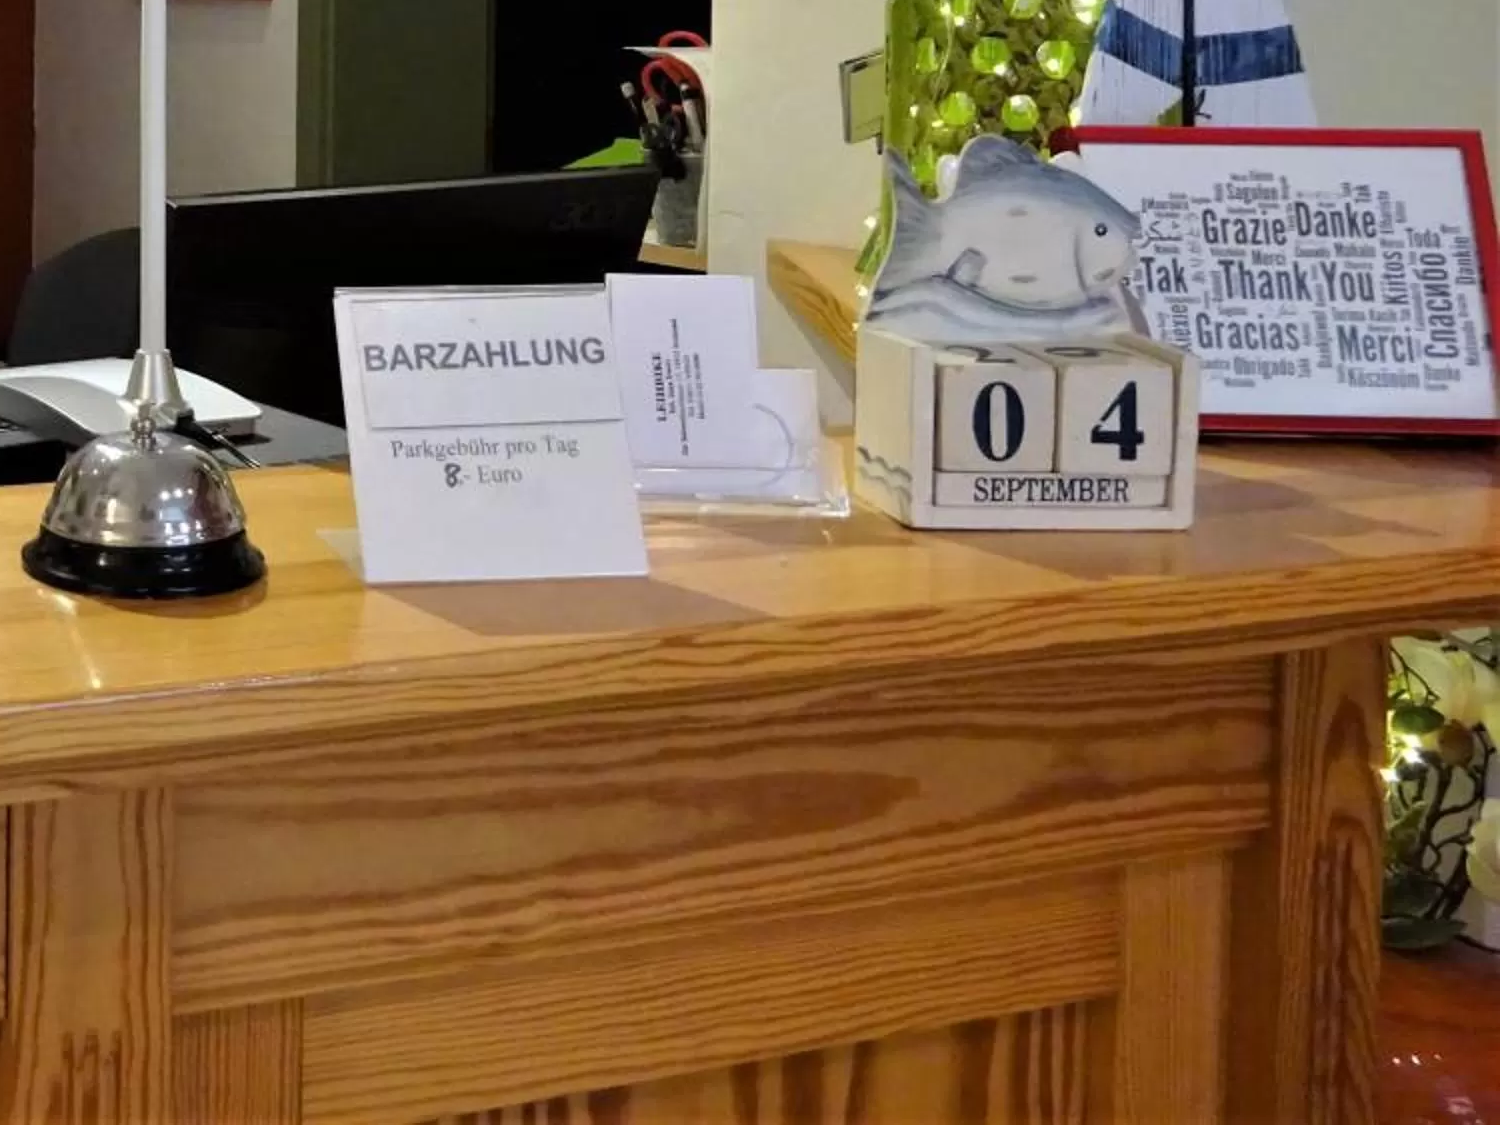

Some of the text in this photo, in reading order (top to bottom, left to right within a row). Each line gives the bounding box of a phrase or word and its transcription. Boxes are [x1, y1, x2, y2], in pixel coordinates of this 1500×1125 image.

[1202, 208, 1288, 246] Grazie
[1294, 201, 1377, 238] Danke
[1140, 256, 1188, 293] Tak
[1218, 259, 1312, 302] Thank
[1320, 261, 1375, 302] You
[1381, 250, 1410, 305] Kiitos
[1415, 252, 1459, 358] Спасибо
[1195, 312, 1300, 350] Gracias
[1336, 325, 1414, 363] Merci
[363, 336, 606, 372] BARZAHLUNG
[972, 381, 1145, 461] 0 4
[391, 434, 581, 462] Parkgebühr pro Tag
[478, 465, 523, 485] Euro
[974, 477, 1130, 503] SEPTEMBER
